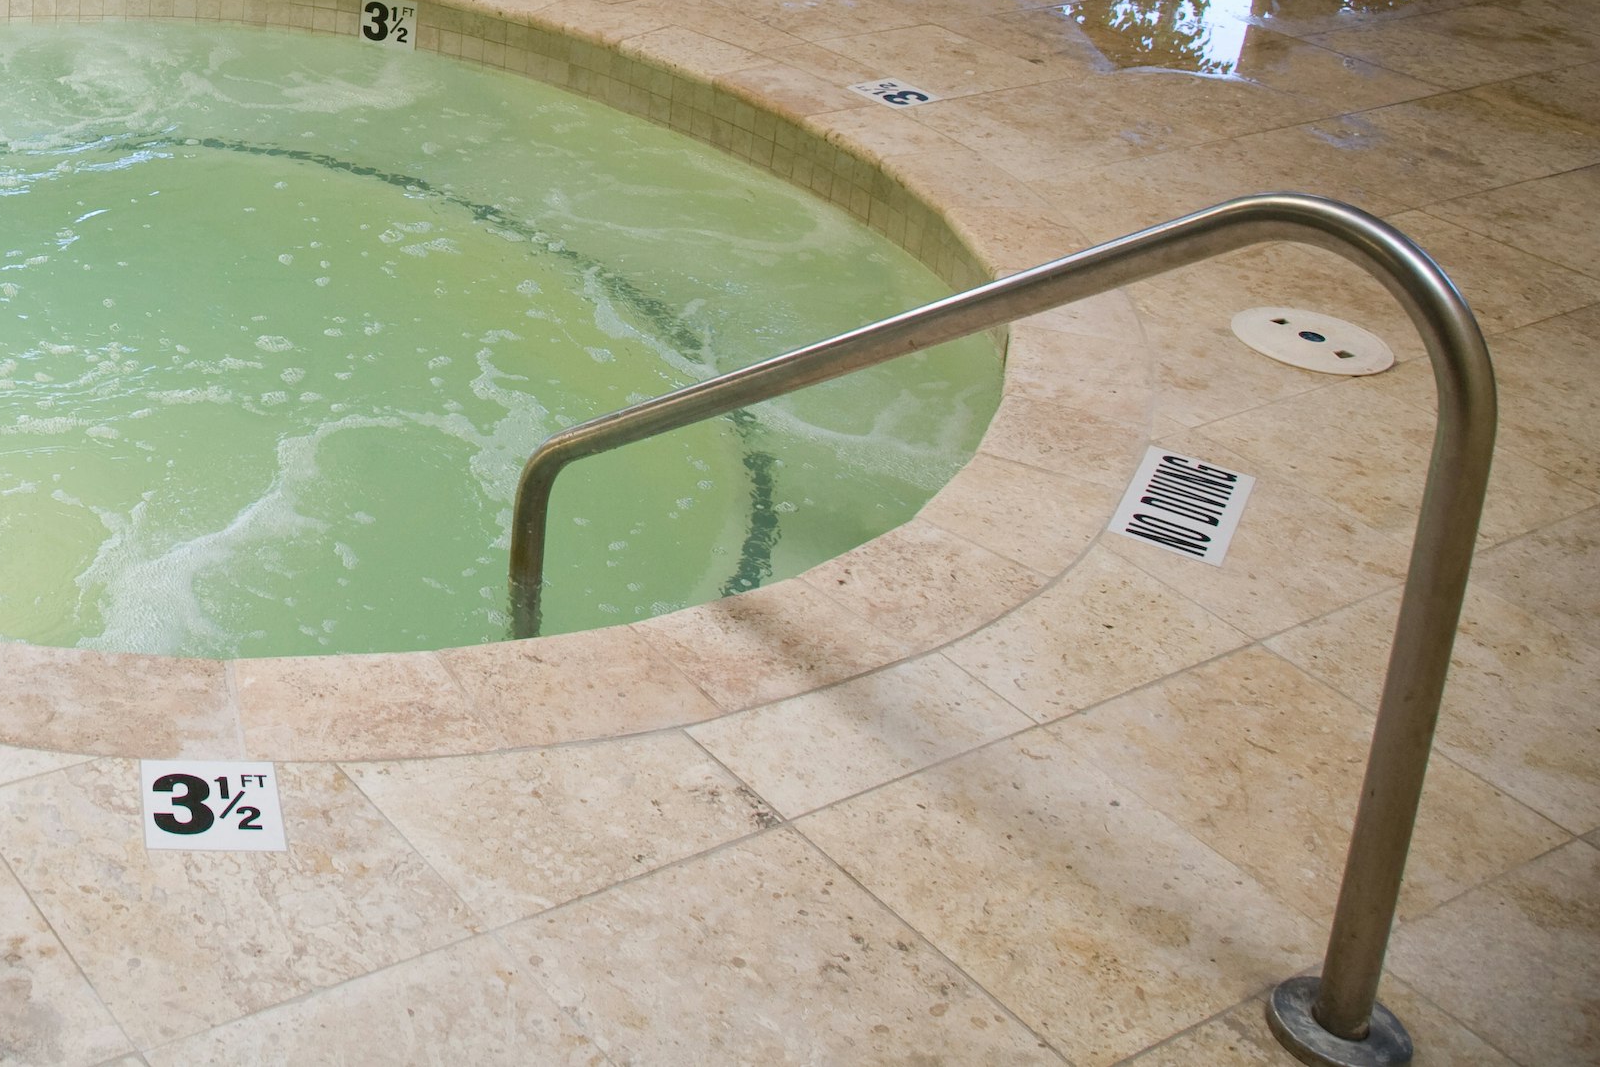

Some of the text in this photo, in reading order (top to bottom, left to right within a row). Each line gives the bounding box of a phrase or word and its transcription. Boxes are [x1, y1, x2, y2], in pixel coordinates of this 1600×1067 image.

[402, 6, 415, 18] FT
[1125, 455, 1238, 557] NO DIVING
[240, 774, 267, 788] FT
